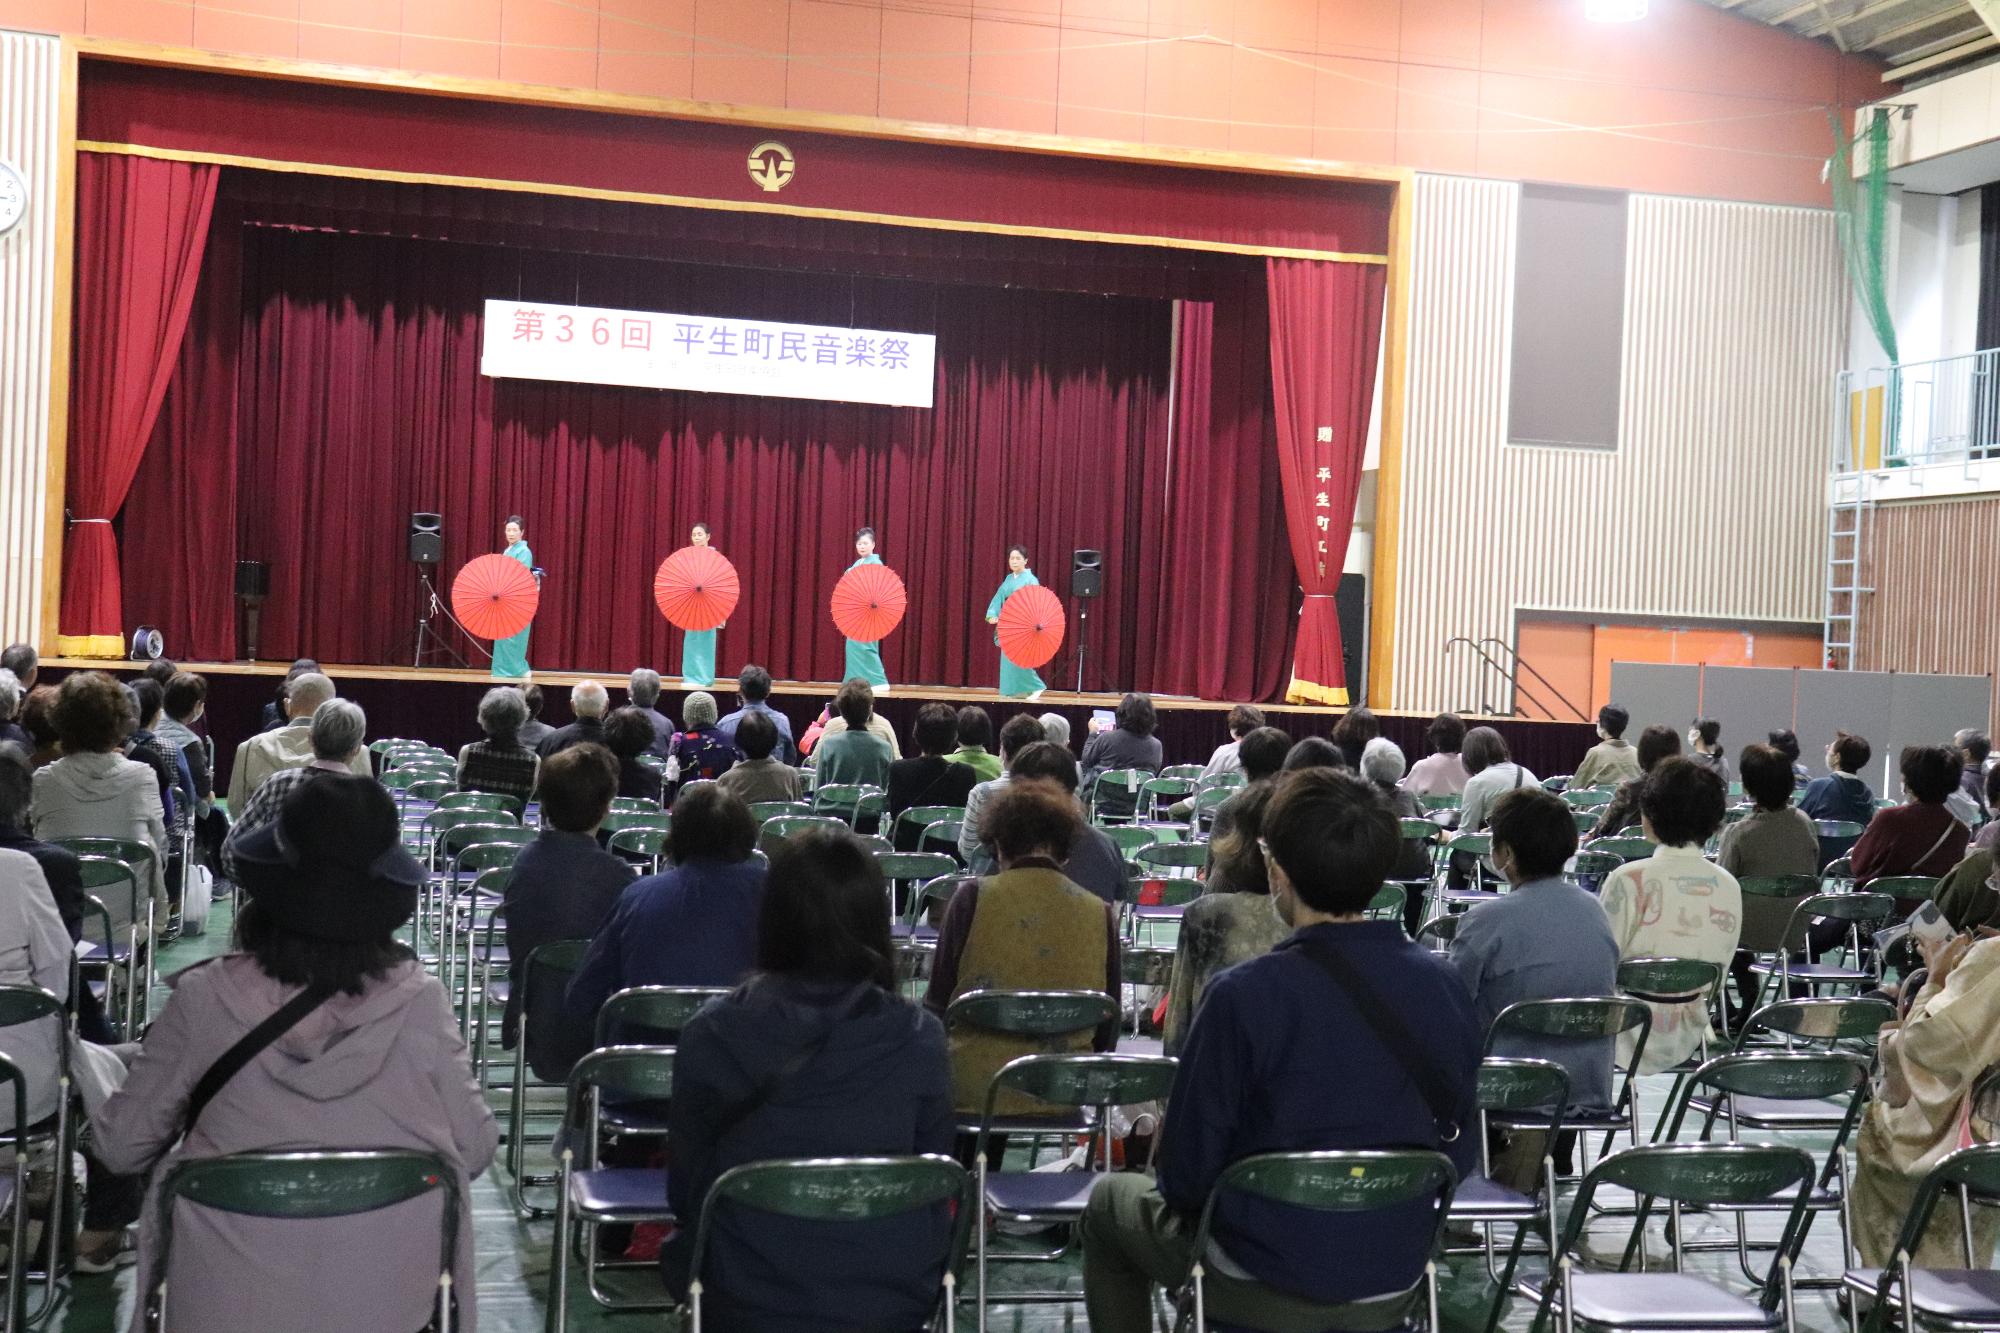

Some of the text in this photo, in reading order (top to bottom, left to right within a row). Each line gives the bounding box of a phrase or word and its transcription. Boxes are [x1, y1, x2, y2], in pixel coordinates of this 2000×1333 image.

[512, 308, 652, 352] 第36回
[673, 321, 911, 370] 平生町民音楽祭
